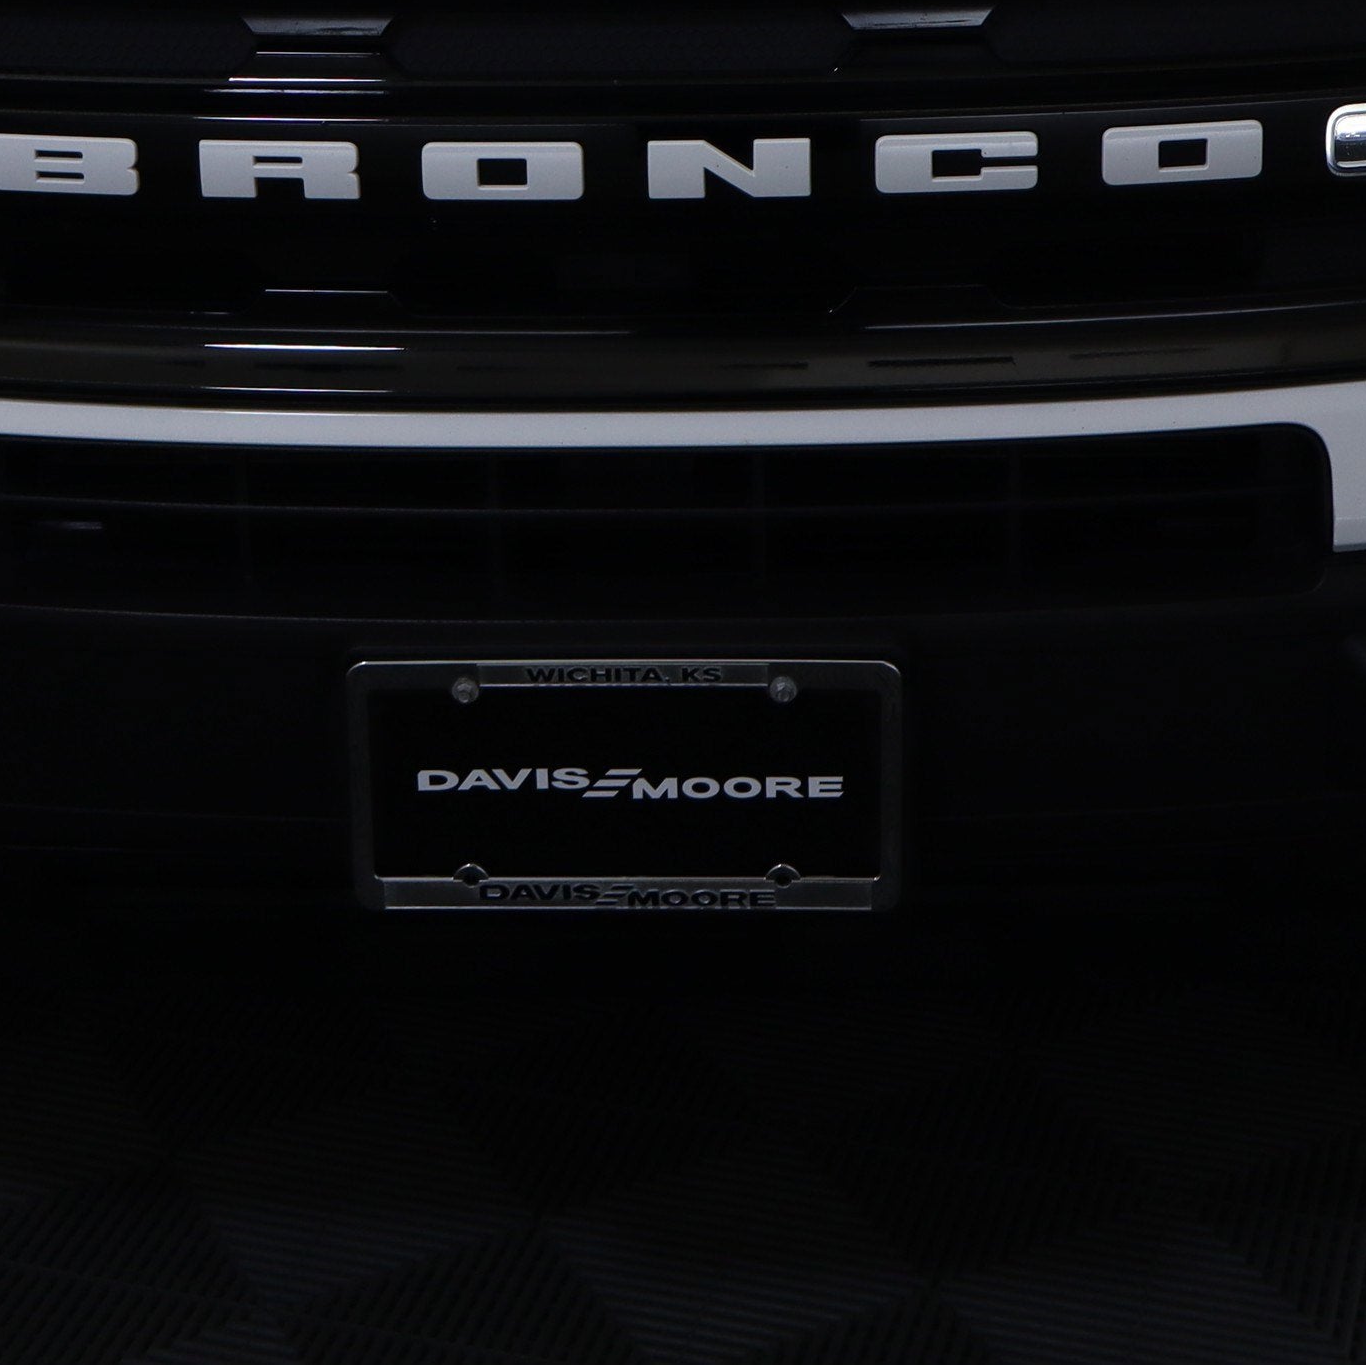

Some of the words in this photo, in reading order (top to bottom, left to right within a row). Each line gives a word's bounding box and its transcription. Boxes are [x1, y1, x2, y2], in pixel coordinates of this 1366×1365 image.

[682, 667, 722, 683] KS
[417, 767, 590, 792] DAVIS
[632, 776, 845, 800] MOORE
[479, 884, 601, 901] DAVIS
[628, 889, 777, 908] MOORE
